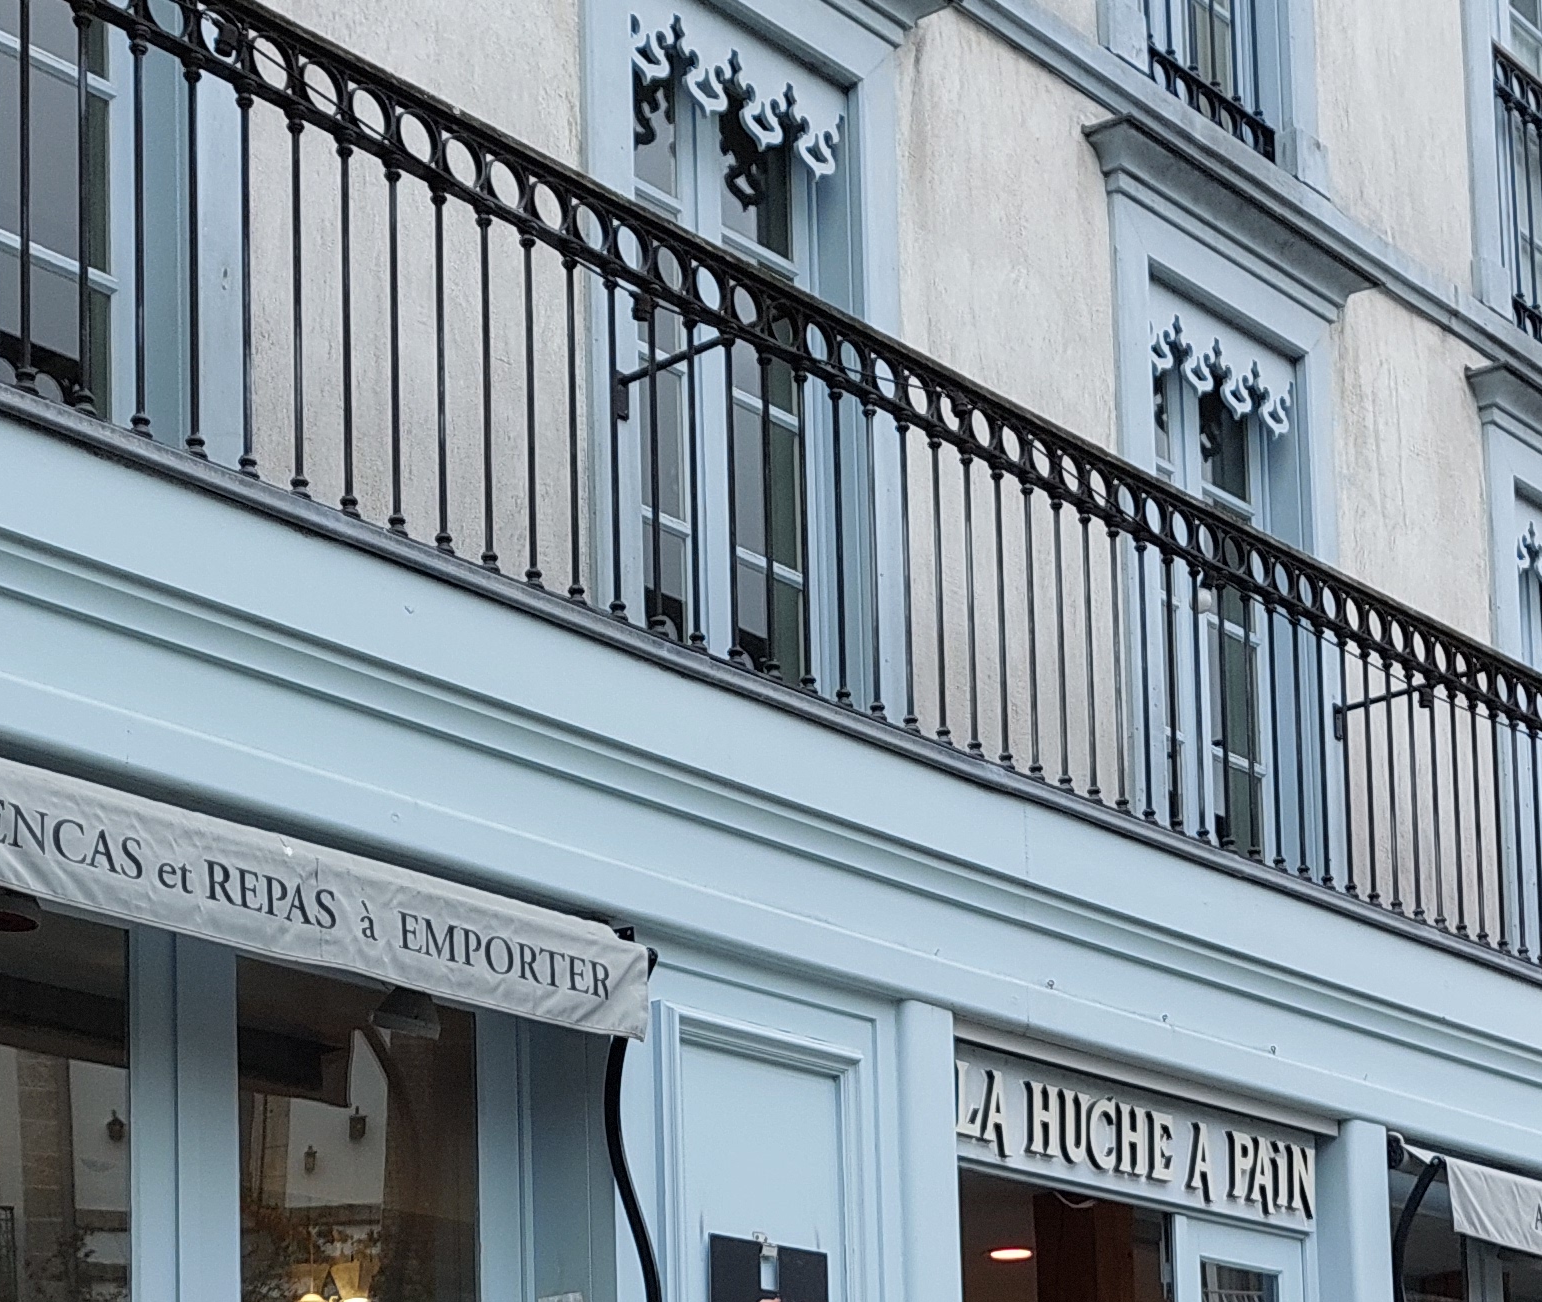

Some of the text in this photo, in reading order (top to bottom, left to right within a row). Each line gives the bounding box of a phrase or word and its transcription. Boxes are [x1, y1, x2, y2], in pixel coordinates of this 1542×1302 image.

[157, 860, 193, 896] et
[204, 859, 339, 931] REPAS
[360, 899, 378, 942] à
[398, 911, 612, 1001] EMPORTER
[955, 1059, 1012, 1158] LA
[1020, 1077, 1175, 1183] HUCHE
[1183, 1120, 1215, 1203] A
